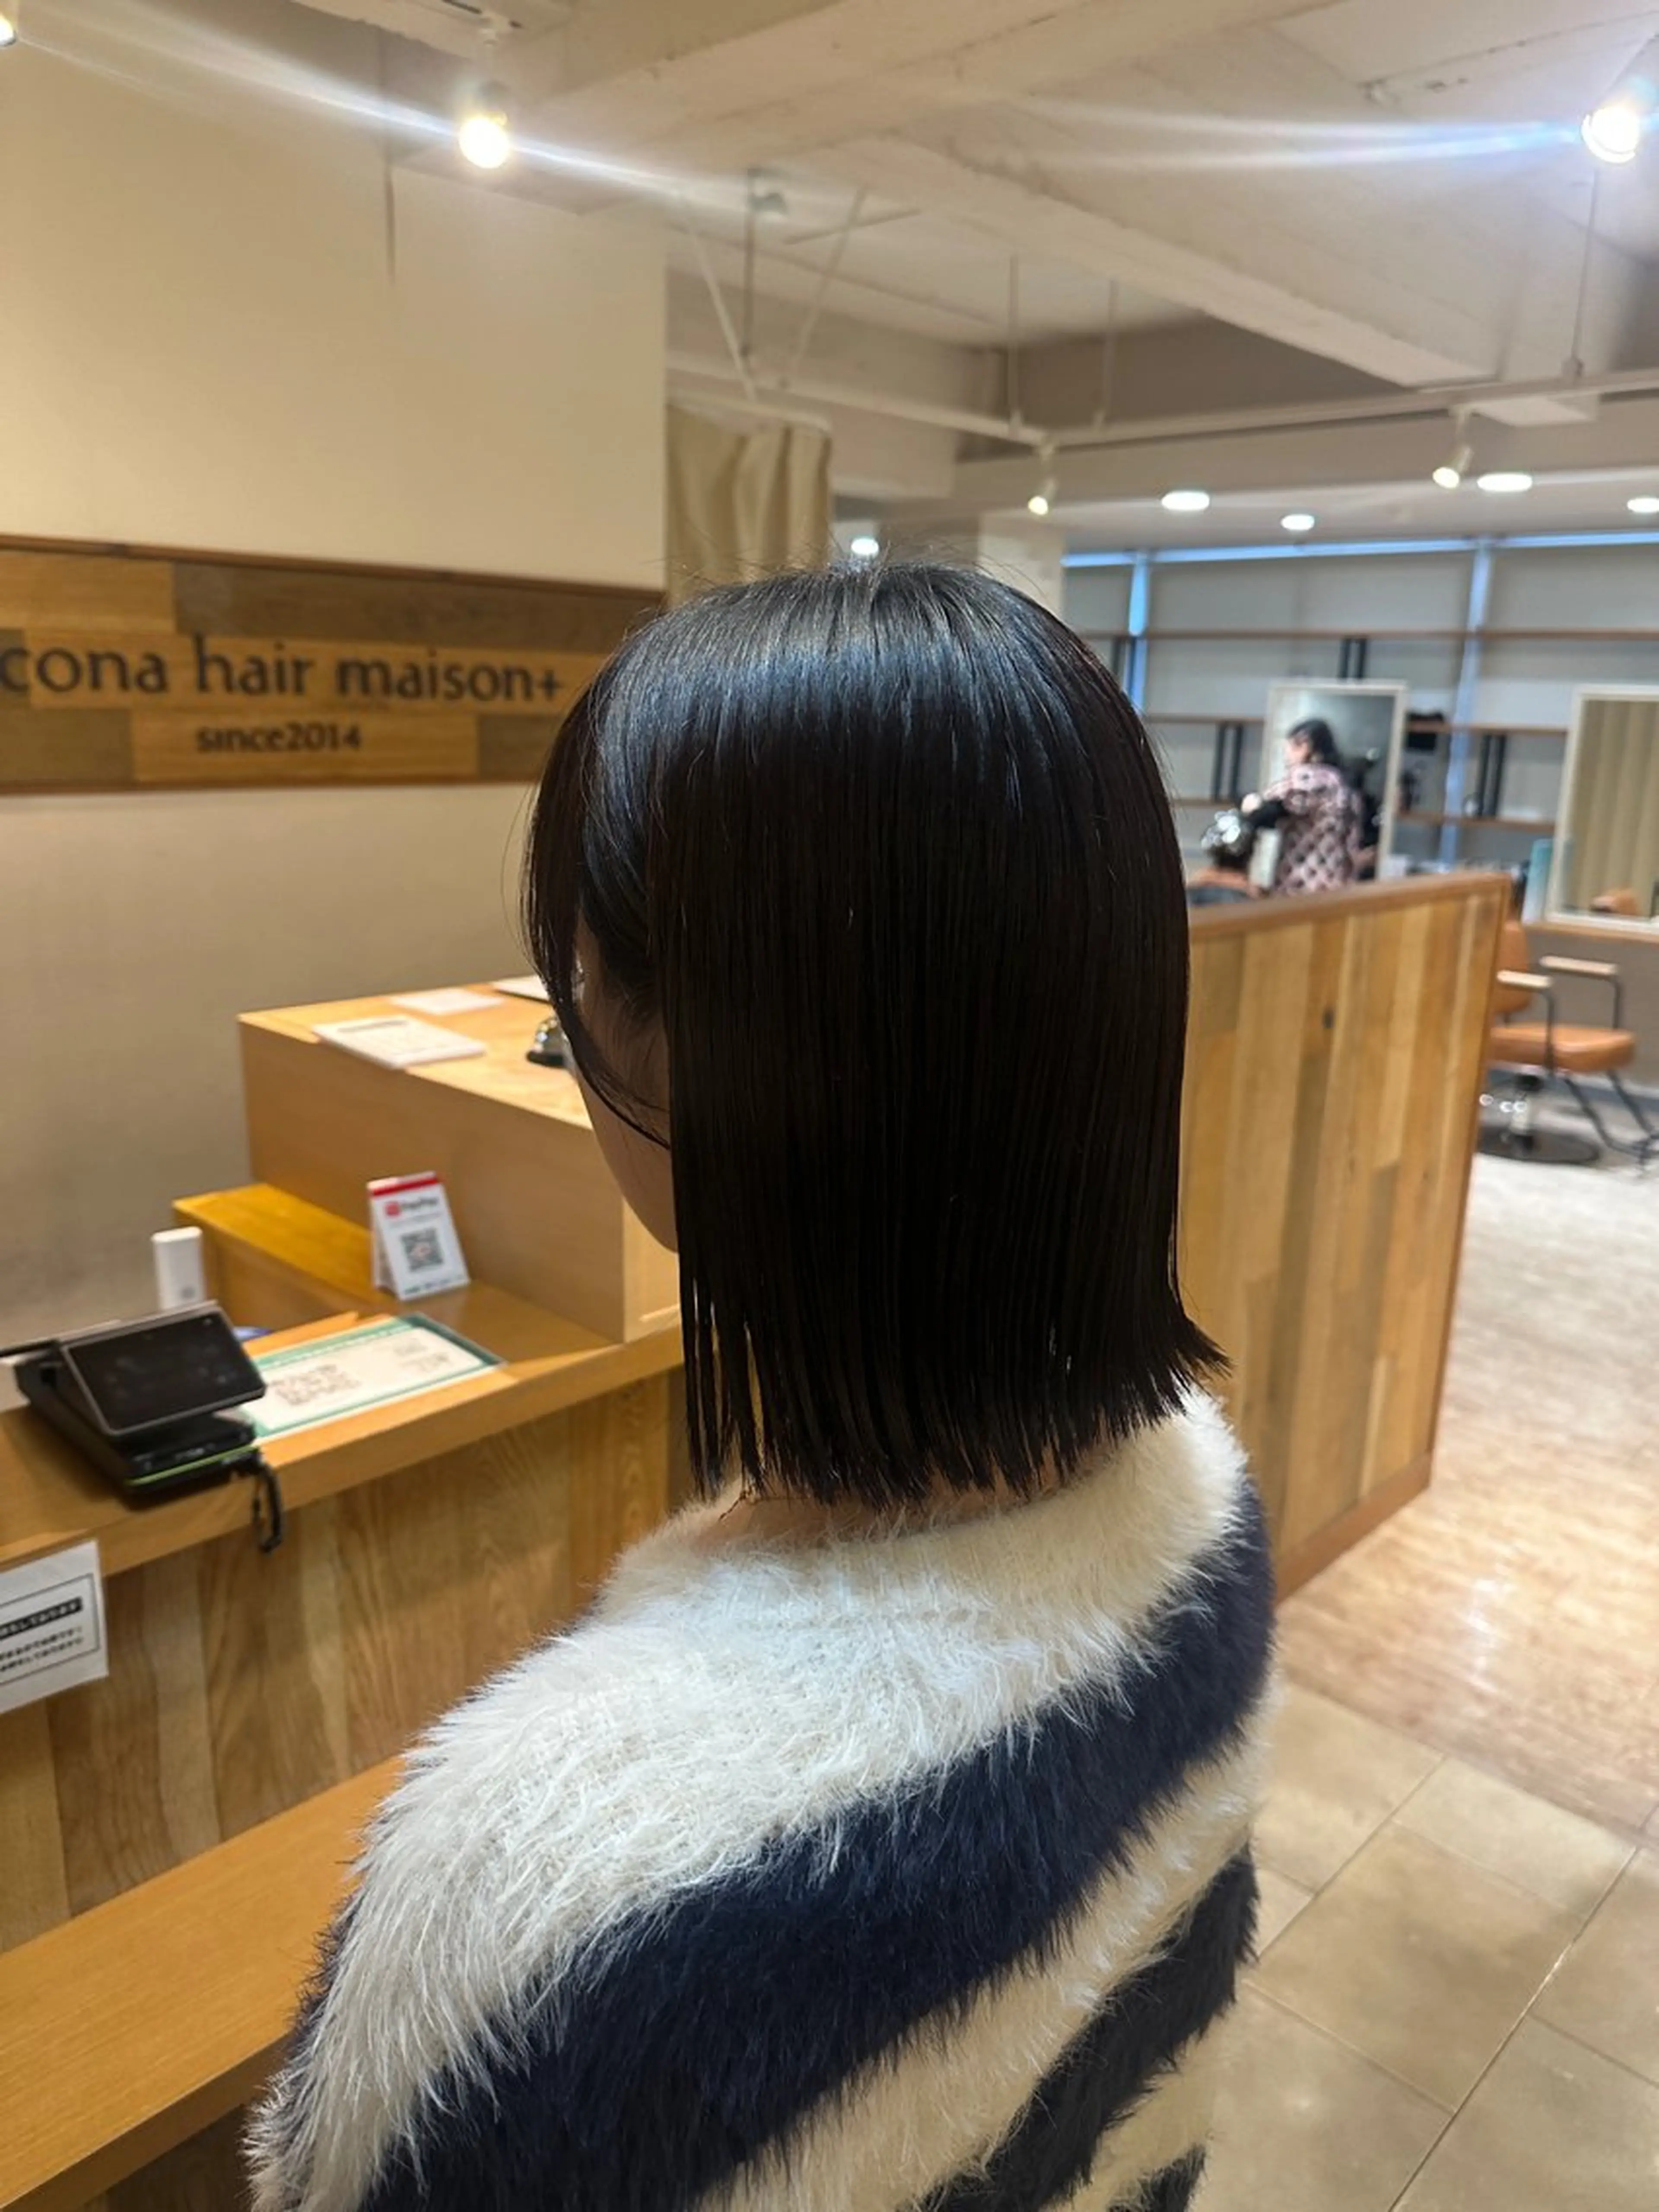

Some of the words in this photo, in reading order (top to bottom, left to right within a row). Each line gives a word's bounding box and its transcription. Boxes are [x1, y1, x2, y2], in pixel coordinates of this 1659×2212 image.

[0, 647, 168, 693] cona
[193, 632, 317, 696] hair
[335, 648, 563, 702] maison+
[197, 721, 361, 753] since2014
